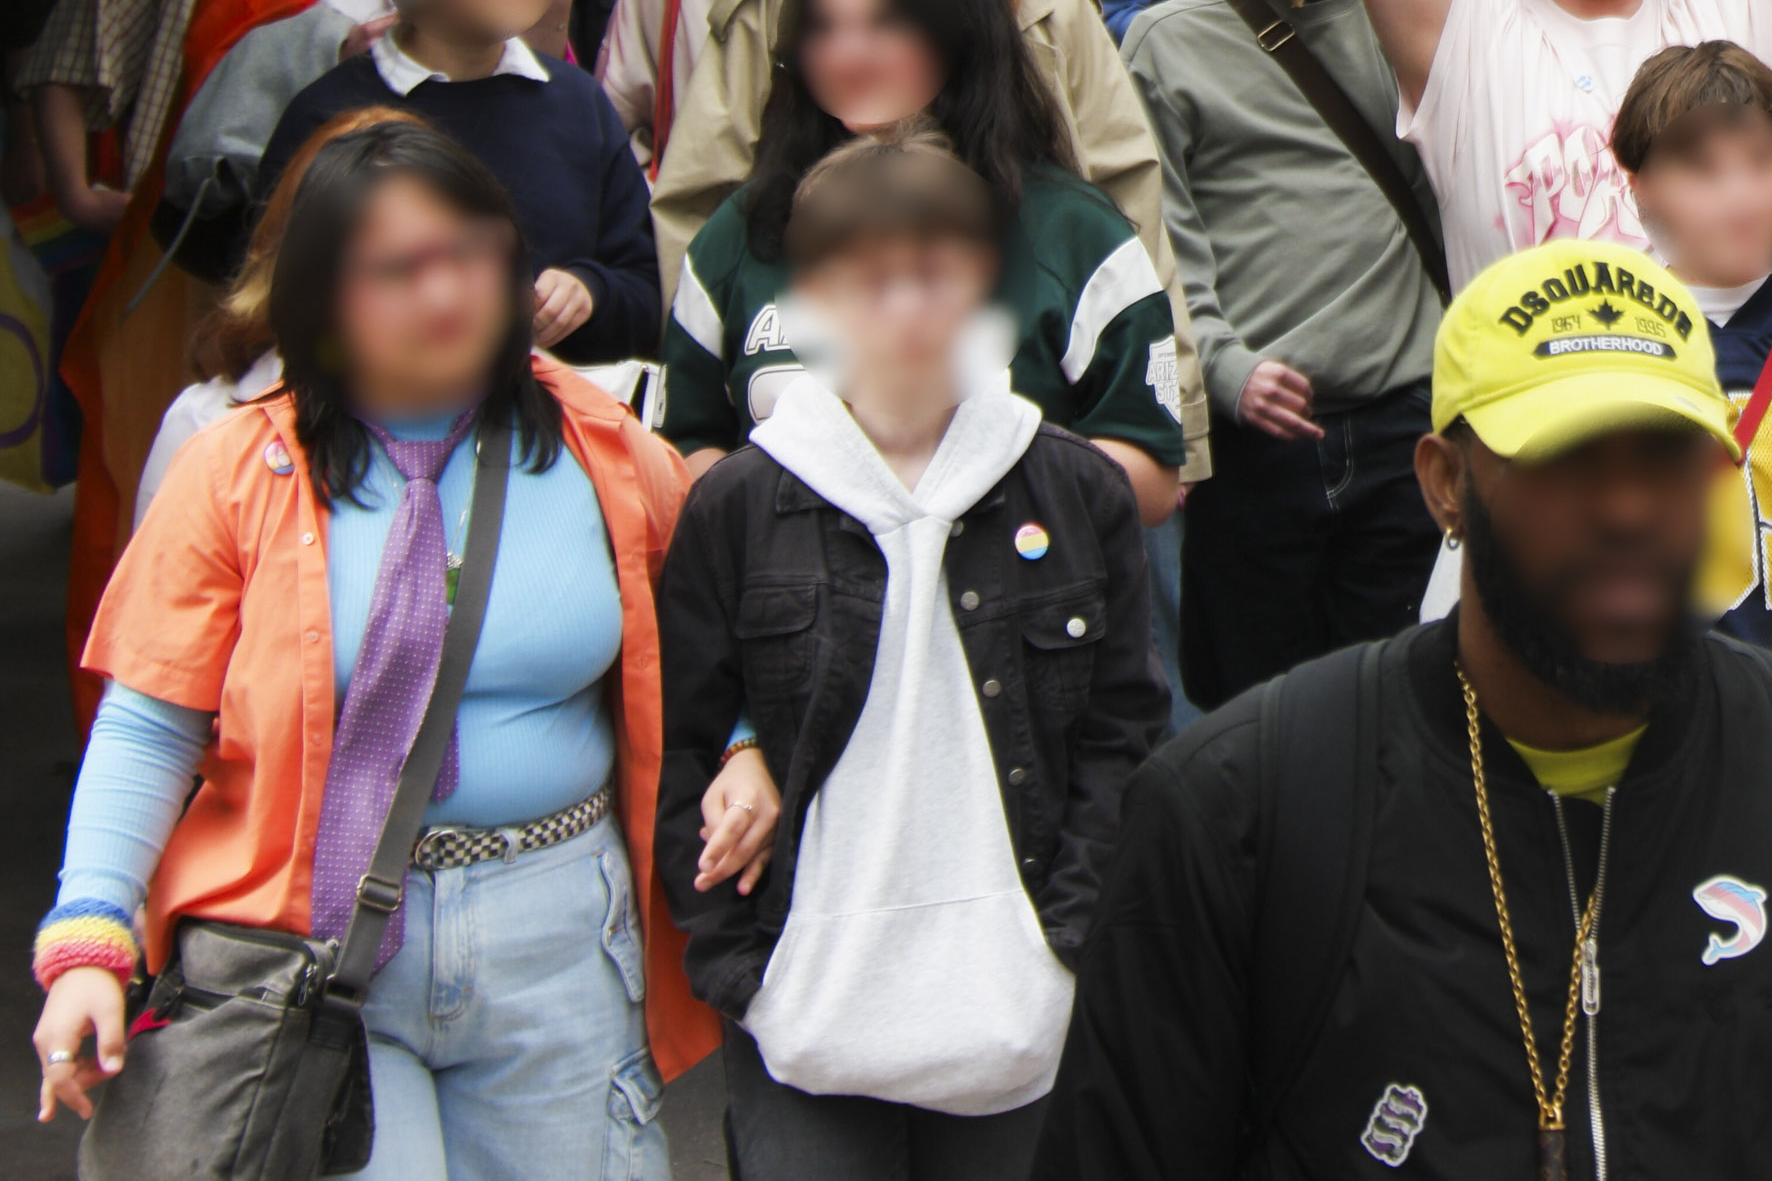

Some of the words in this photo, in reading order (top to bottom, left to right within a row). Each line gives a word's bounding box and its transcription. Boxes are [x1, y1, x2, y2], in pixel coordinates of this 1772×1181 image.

[1551, 314, 1583, 334] 1964
[1633, 316, 1667, 338] 1995
[1547, 335, 1665, 357] BROTHERHOOD
